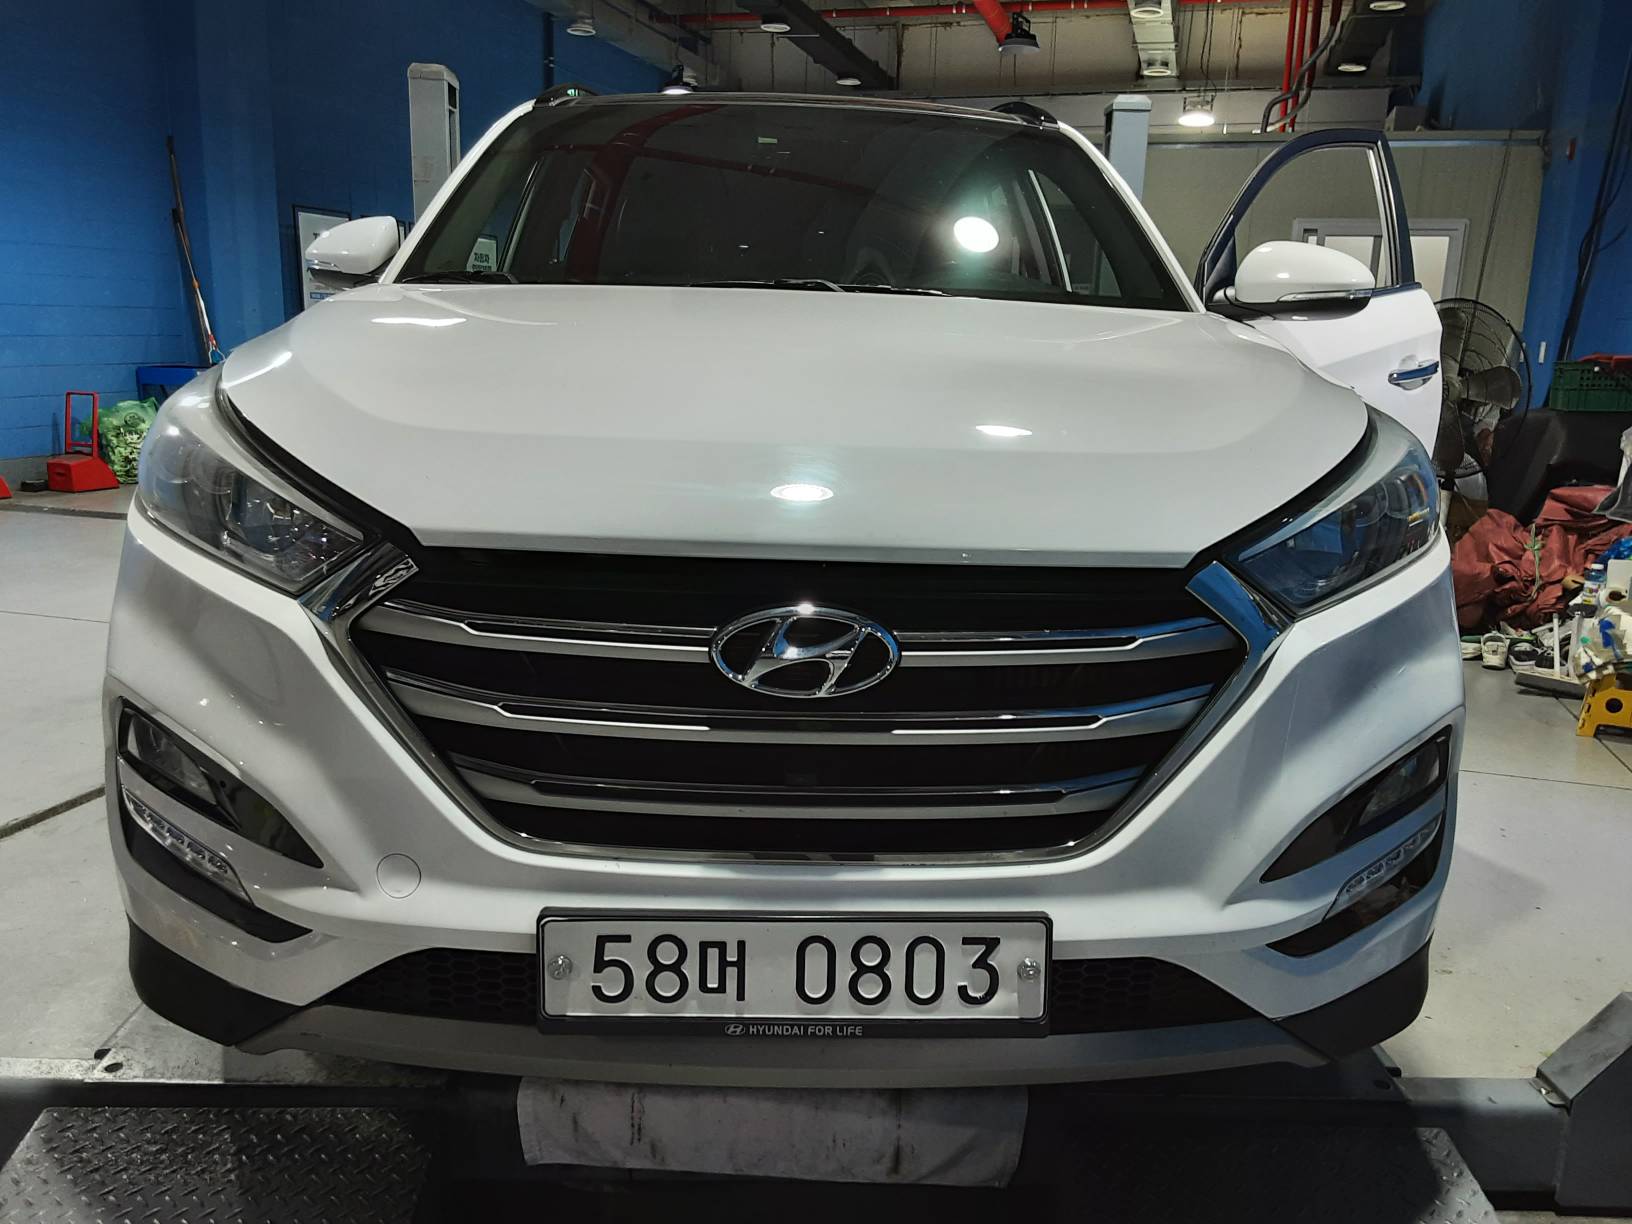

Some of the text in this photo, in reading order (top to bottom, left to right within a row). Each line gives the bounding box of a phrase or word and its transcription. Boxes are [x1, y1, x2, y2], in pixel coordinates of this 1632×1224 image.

[591, 934, 1001, 1006] 58머 0803
[748, 1025, 863, 1036] HYUNDAI FOR LIFE
